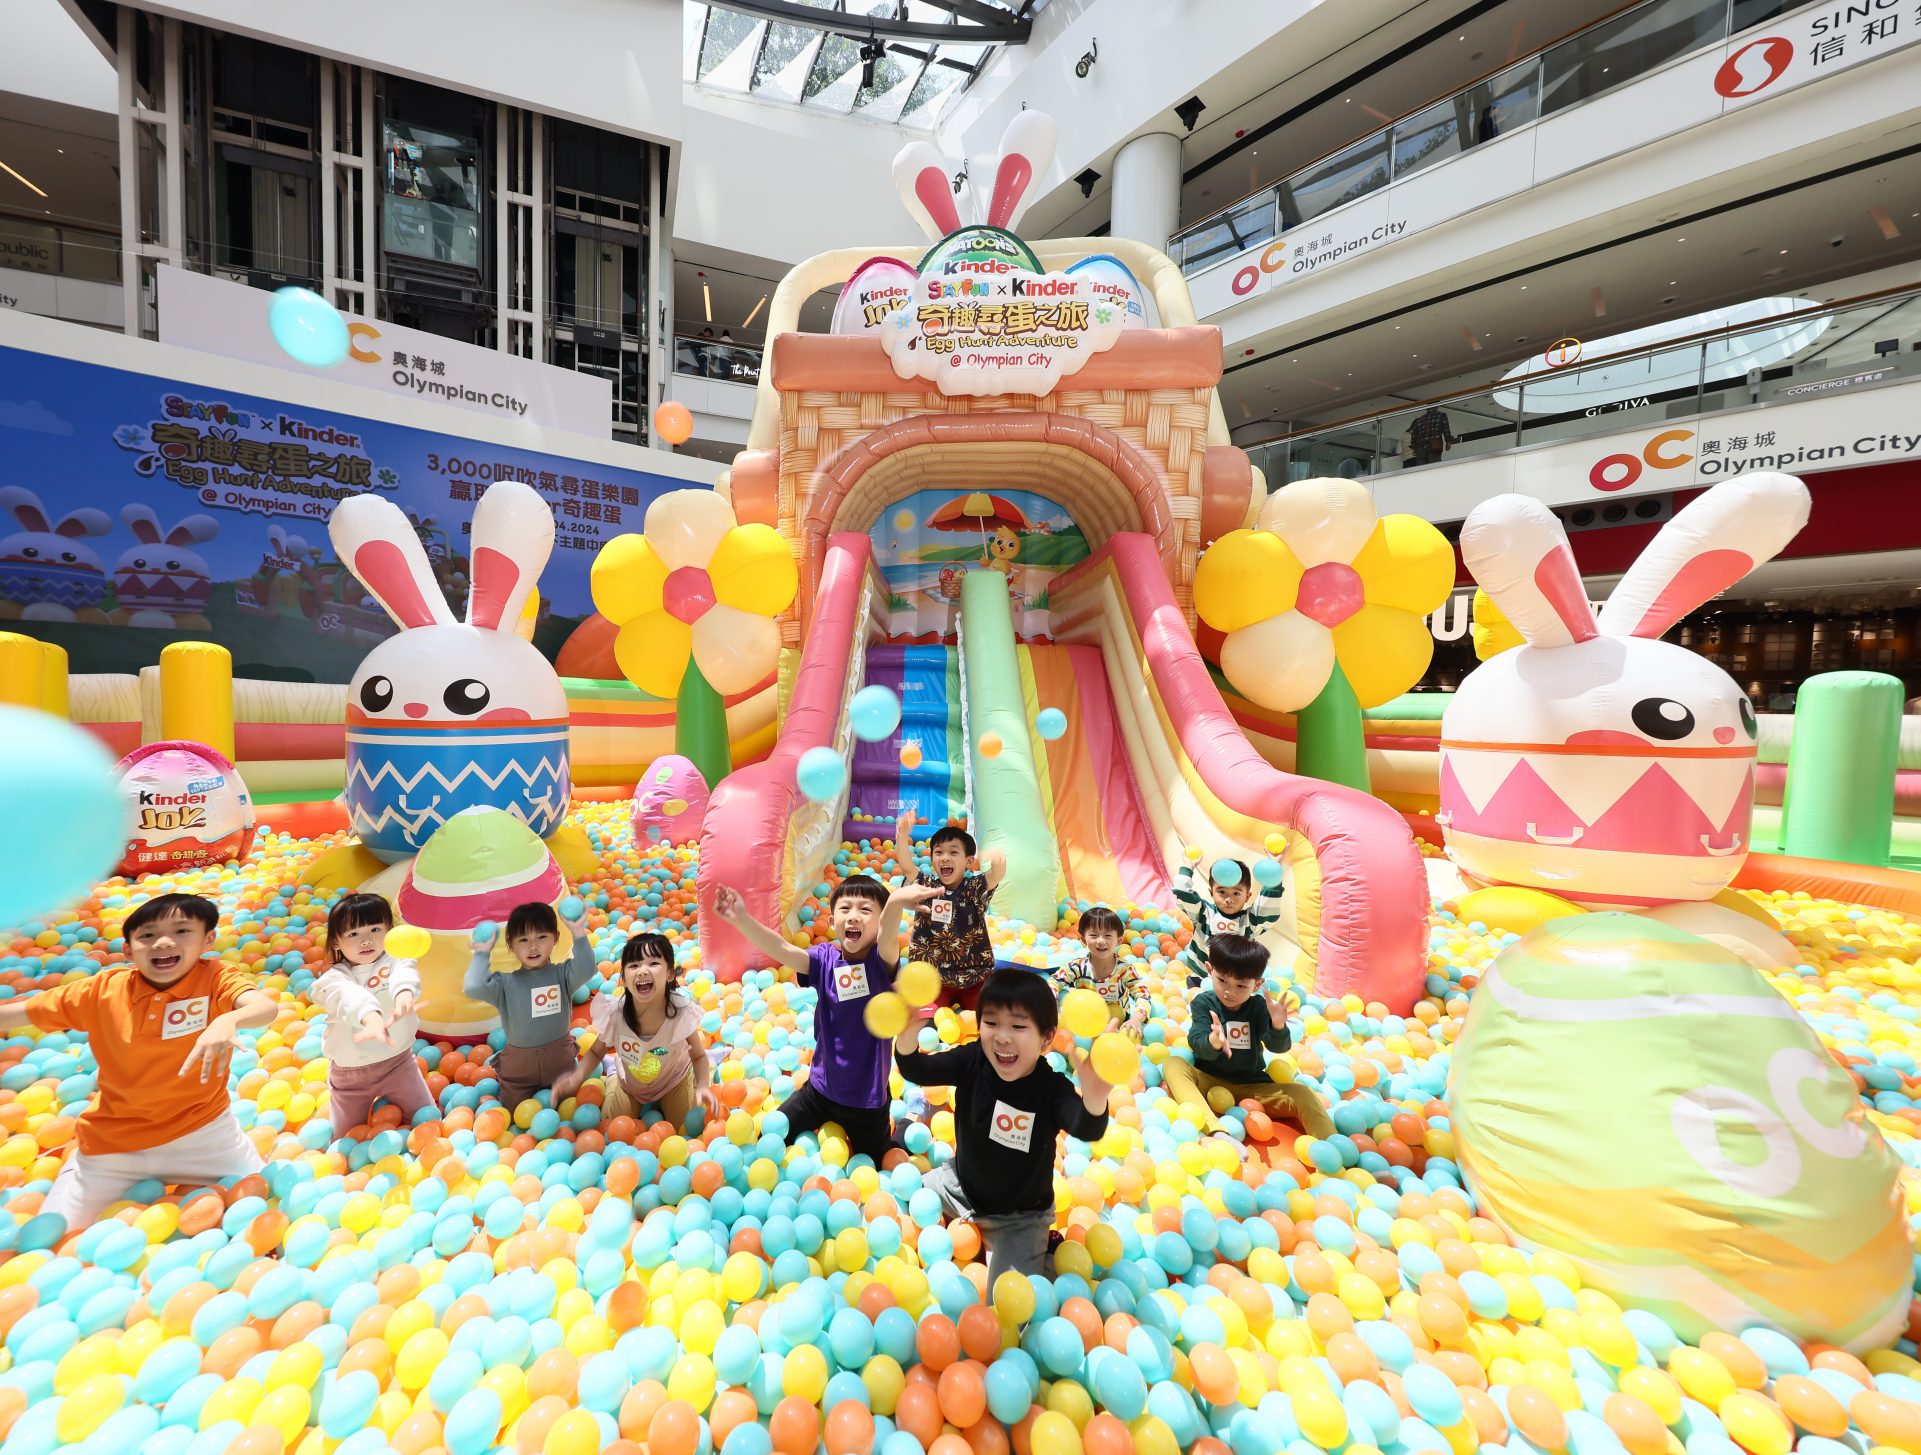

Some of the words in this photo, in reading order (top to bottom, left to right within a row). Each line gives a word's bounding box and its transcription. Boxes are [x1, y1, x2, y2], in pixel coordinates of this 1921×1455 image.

[1292, 236, 1368, 273] Olympian
[1371, 220, 1407, 241] City
[1293, 233, 1333, 260] 奧海城
[1232, 242, 1287, 296] OC
[860, 286, 909, 305] Kinder
[928, 278, 990, 300] STAYFUN
[1012, 278, 1078, 297] Kinder
[1092, 282, 1131, 299] inder
[916, 301, 1090, 337] 奇趣尋蛋之旅
[347, 322, 383, 364] C
[926, 336, 956, 354] Egg
[959, 334, 997, 349] Hunt
[995, 332, 1079, 349] Adventure
[392, 350, 446, 376] 奧海城
[950, 355, 962, 368] @
[966, 352, 1023, 370] Olympian
[1027, 352, 1052, 369] City
[392, 370, 488, 405] Olympian
[491, 392, 528, 416] City
[1787, 379, 1850, 396] CONCIERGE
[279, 416, 360, 448] Kinder
[151, 423, 372, 487] 奇趣尋蛋之旅
[1699, 444, 1846, 476] Olympian
[1853, 434, 1921, 454] City
[1701, 431, 1777, 457] 奧海城
[1589, 429, 1696, 492] OC
[165, 460, 209, 487] Egg
[211, 468, 262, 488] Hunt
[201, 488, 218, 501] @
[224, 491, 297, 515] Olympian
[302, 502, 332, 519] City
[140, 790, 207, 806] Kinder
[934, 903, 952, 915] OC
[1217, 921, 1237, 931] OC
[367, 966, 391, 988] OC
[838, 966, 863, 988] OC
[534, 987, 558, 1006] OC
[1098, 985, 1116, 995] OC
[168, 1001, 204, 1025] OC
[1230, 1024, 1249, 1040] OC
[621, 1041, 640, 1053] OC
[996, 1113, 1030, 1132] OC
[1671, 1047, 1866, 1199] OC
